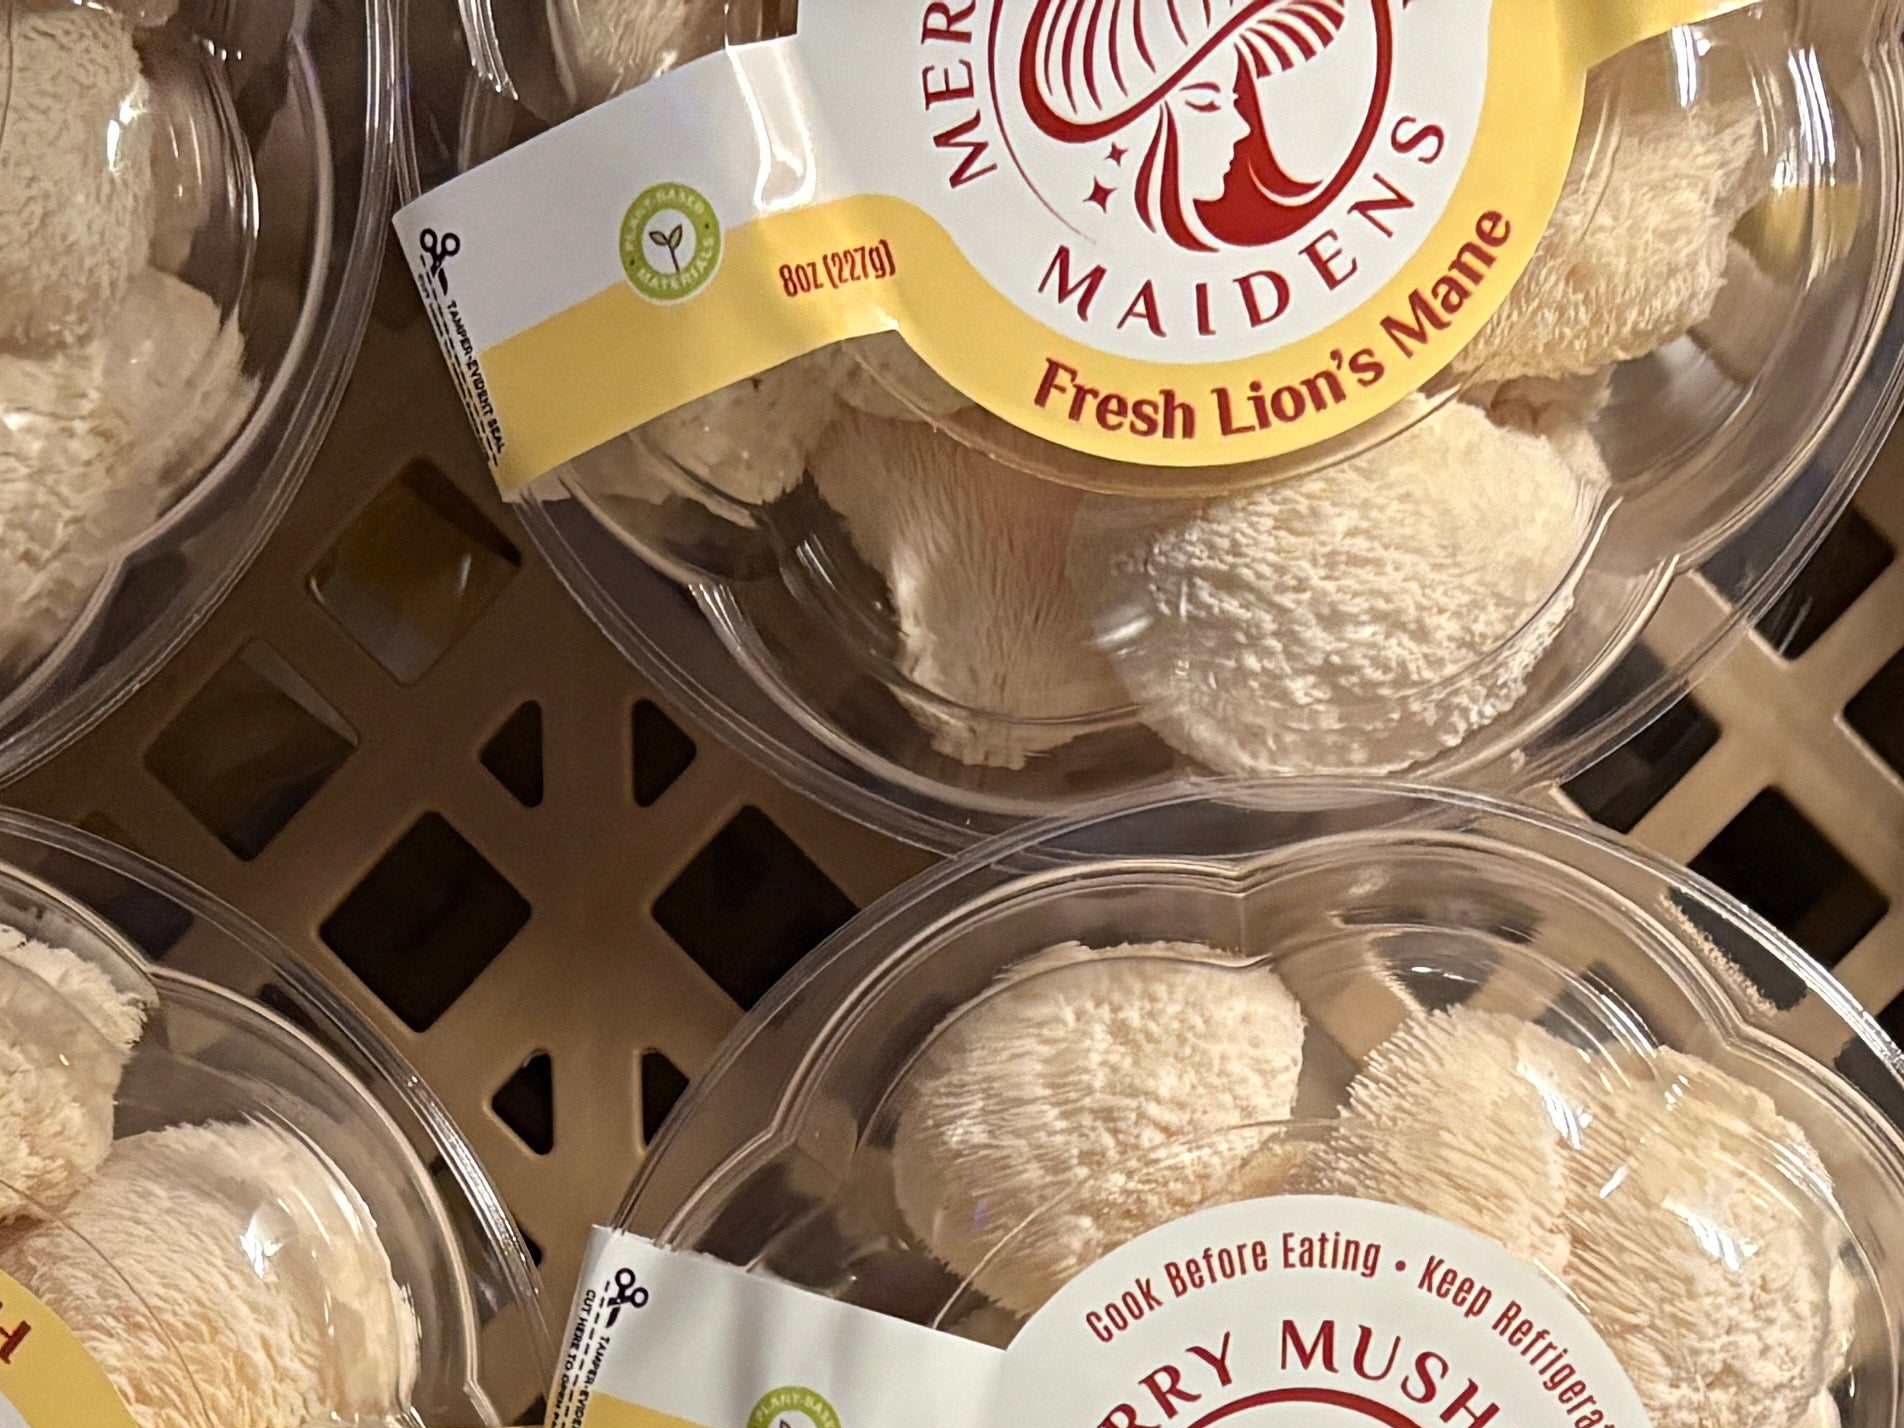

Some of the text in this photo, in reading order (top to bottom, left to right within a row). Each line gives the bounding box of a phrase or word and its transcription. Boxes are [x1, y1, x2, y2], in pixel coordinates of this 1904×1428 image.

[923, 0, 995, 186] MER
[778, 239, 896, 297] 8oz (227g)
[1043, 117, 1444, 335] MAIDENS
[1035, 207, 1512, 438] Fresh Lion's Mane
[1086, 1280, 1163, 1343] Cook
[1165, 1241, 1268, 1297] Before
[1283, 1233, 1381, 1278] Eating
[1419, 1257, 1492, 1317] Keep
